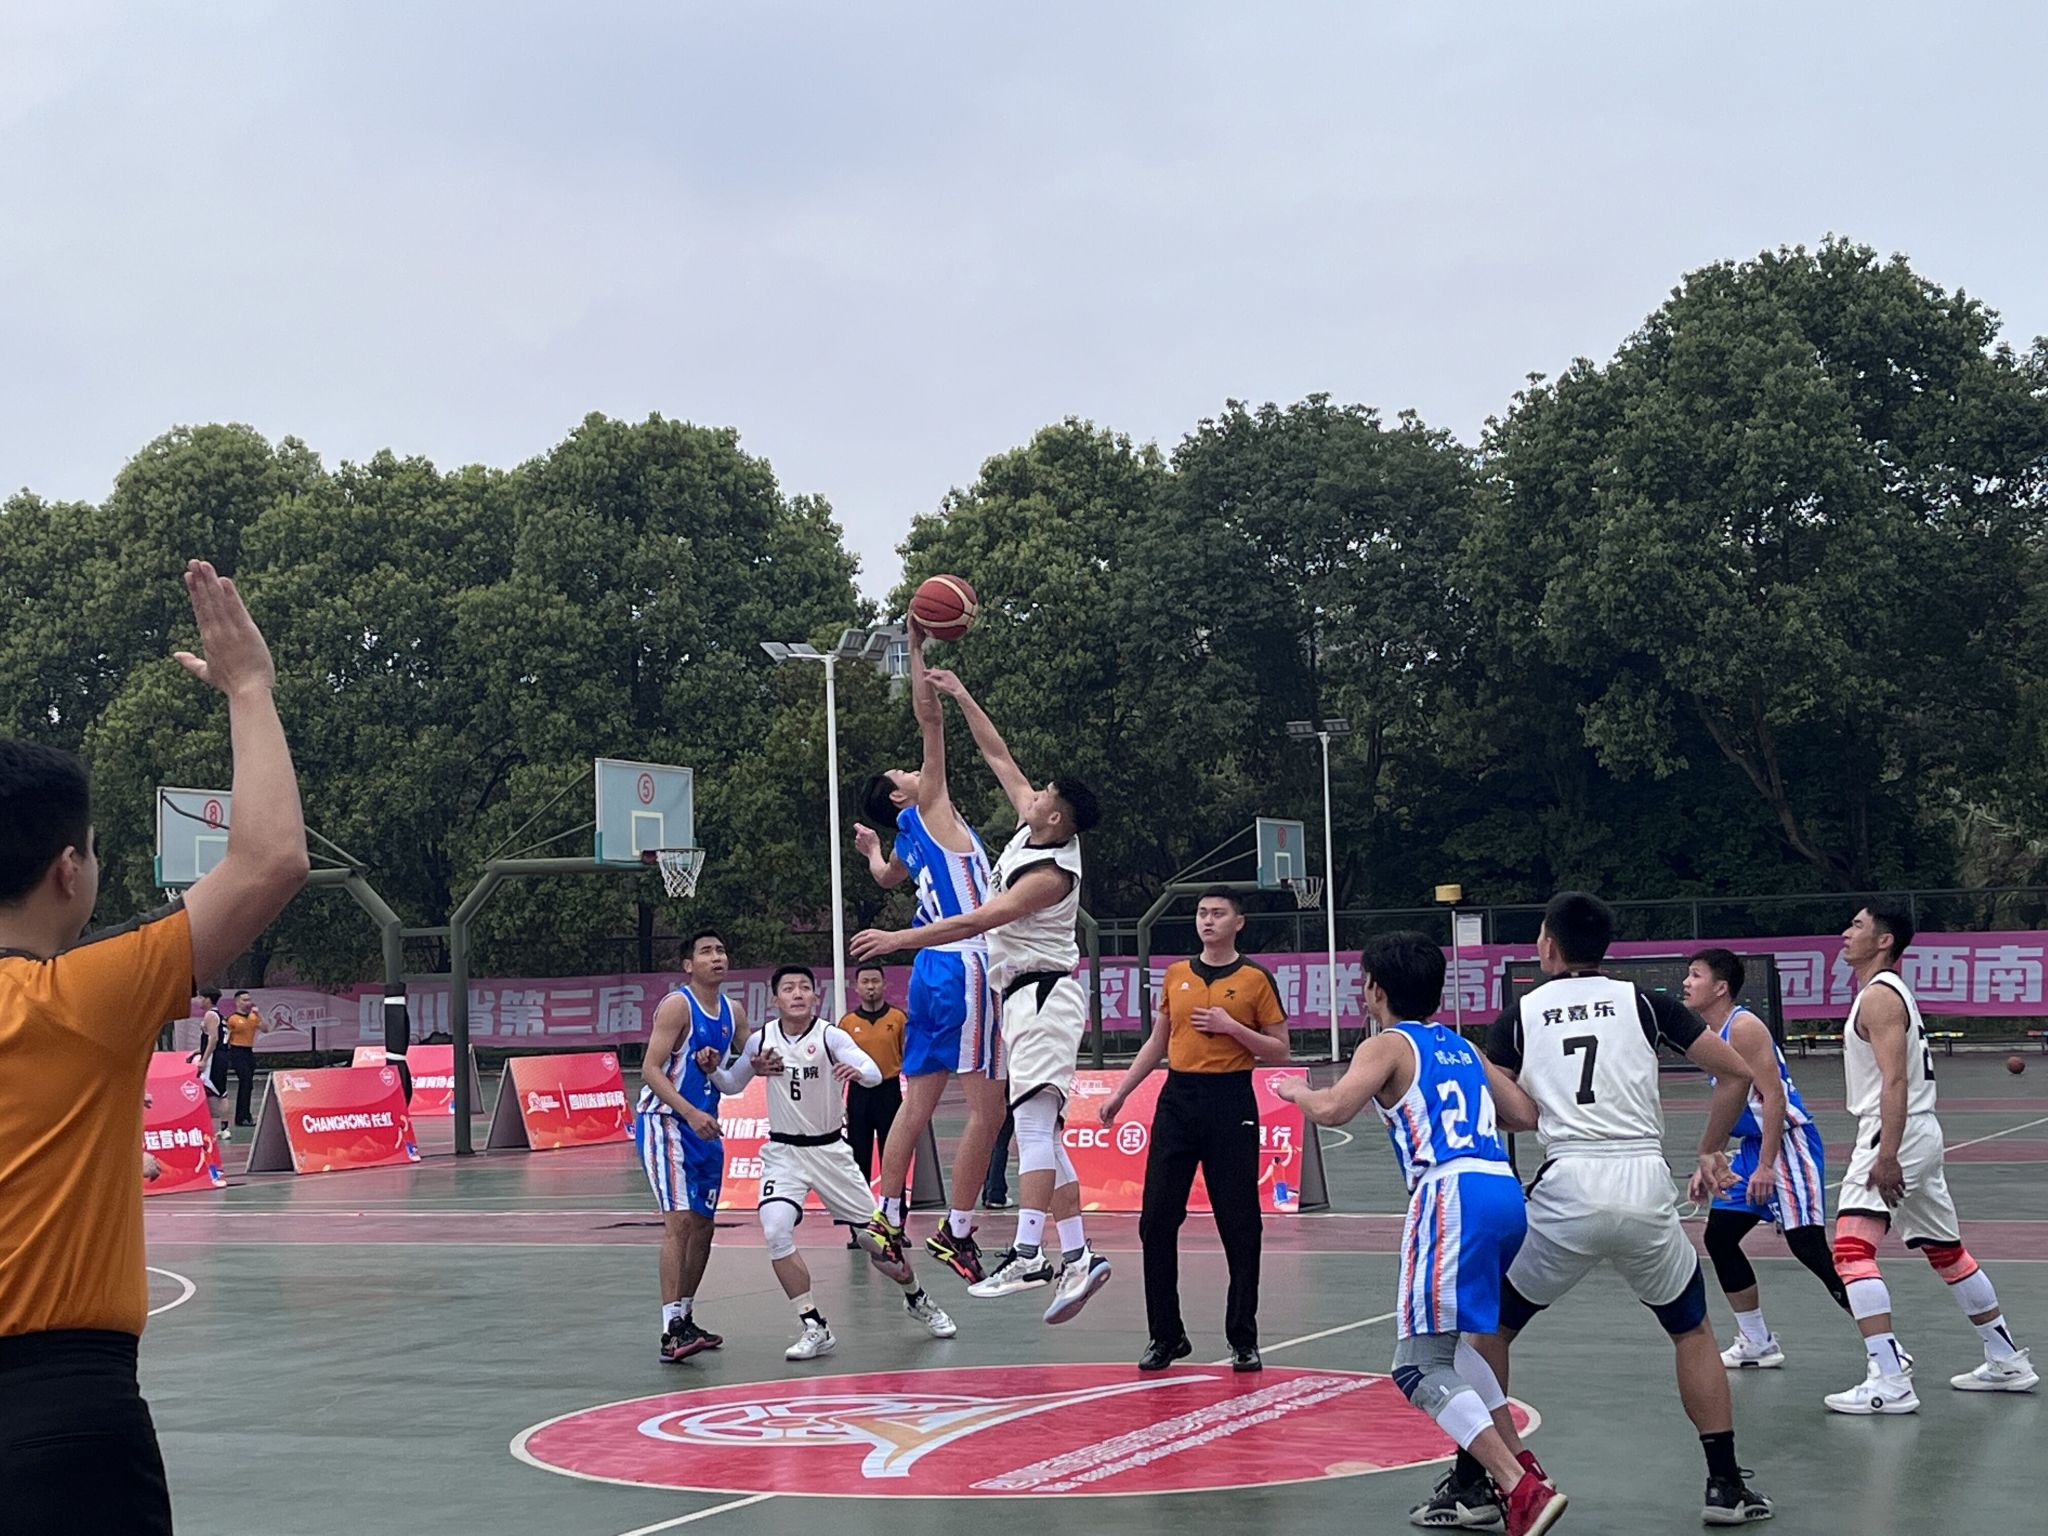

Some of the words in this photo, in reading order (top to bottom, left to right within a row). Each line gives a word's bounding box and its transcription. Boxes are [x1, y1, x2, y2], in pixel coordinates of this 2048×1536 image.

[1542, 1000, 1616, 1027] 党嘉乐
[1562, 1034, 1599, 1105] 7
[790, 1080, 802, 1101] 6
[302, 1114, 370, 1134] CHANGHONG
[1436, 1079, 1501, 1150] 24
[762, 1179, 776, 1197] 6
